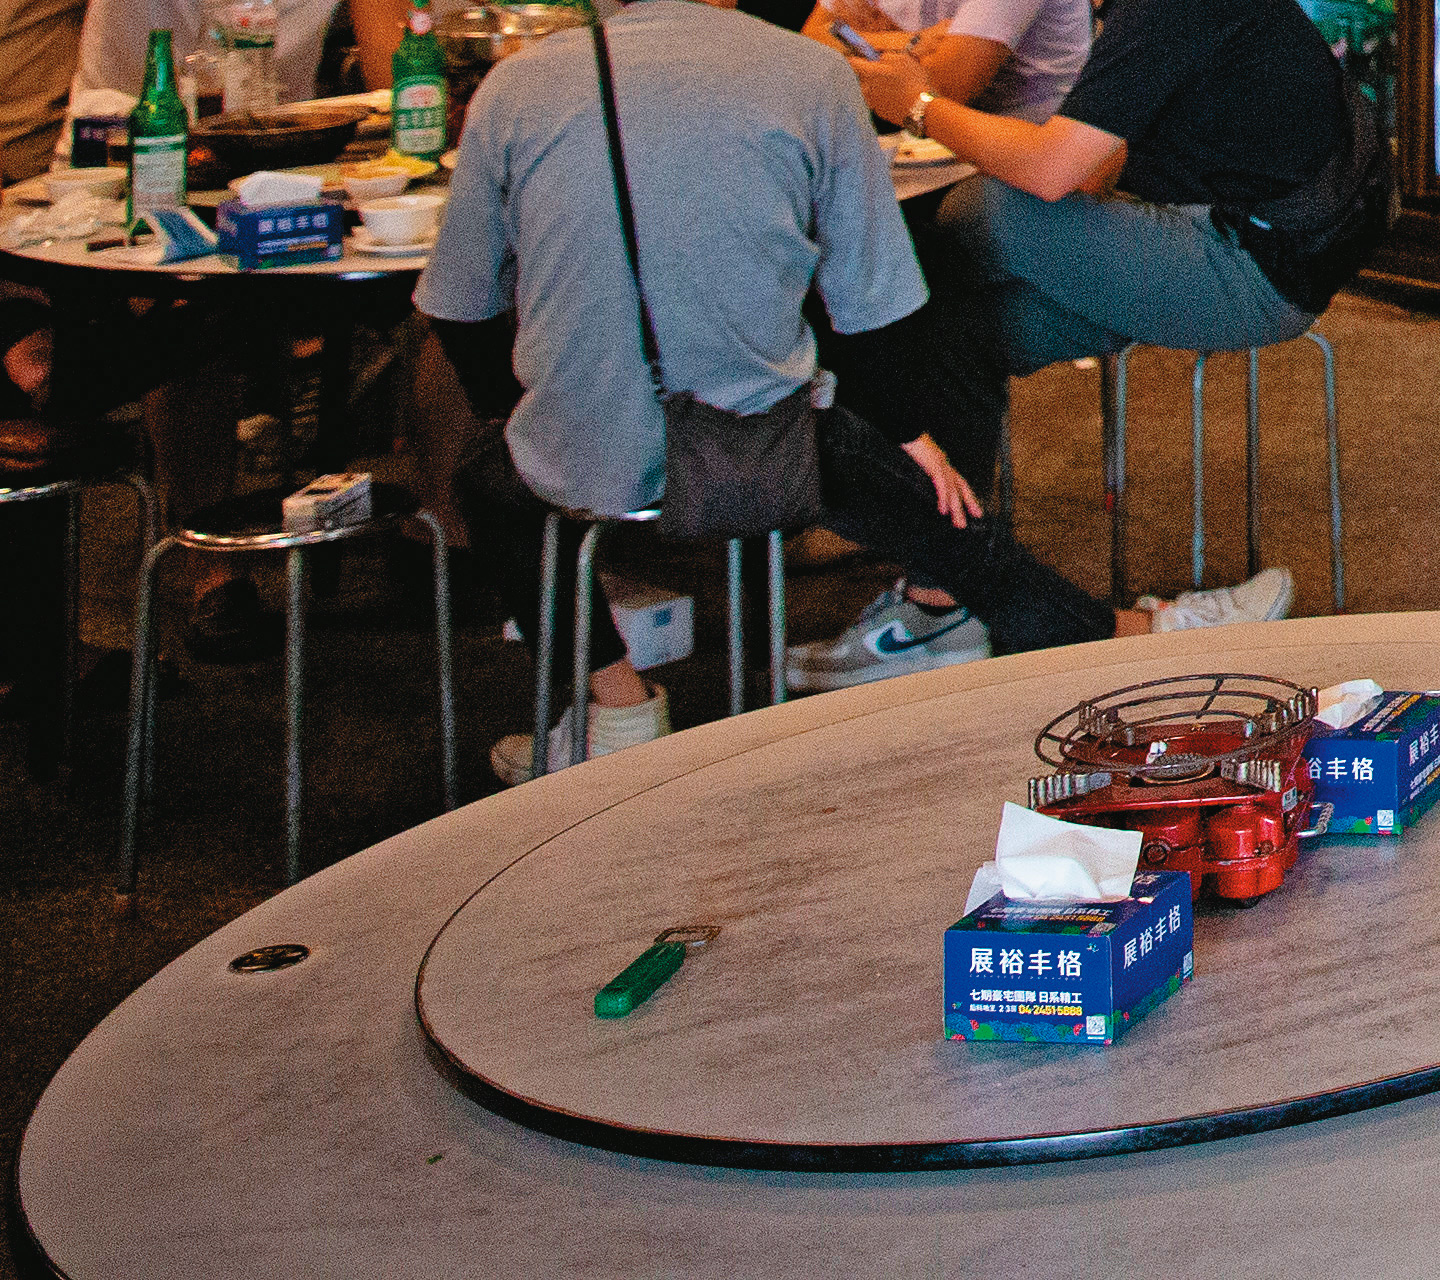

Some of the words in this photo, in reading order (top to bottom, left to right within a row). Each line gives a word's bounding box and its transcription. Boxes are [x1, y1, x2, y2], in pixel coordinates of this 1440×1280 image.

[1123, 904, 1181, 970] 展裕丰格
[969, 947, 1083, 977] 展裕丰格
